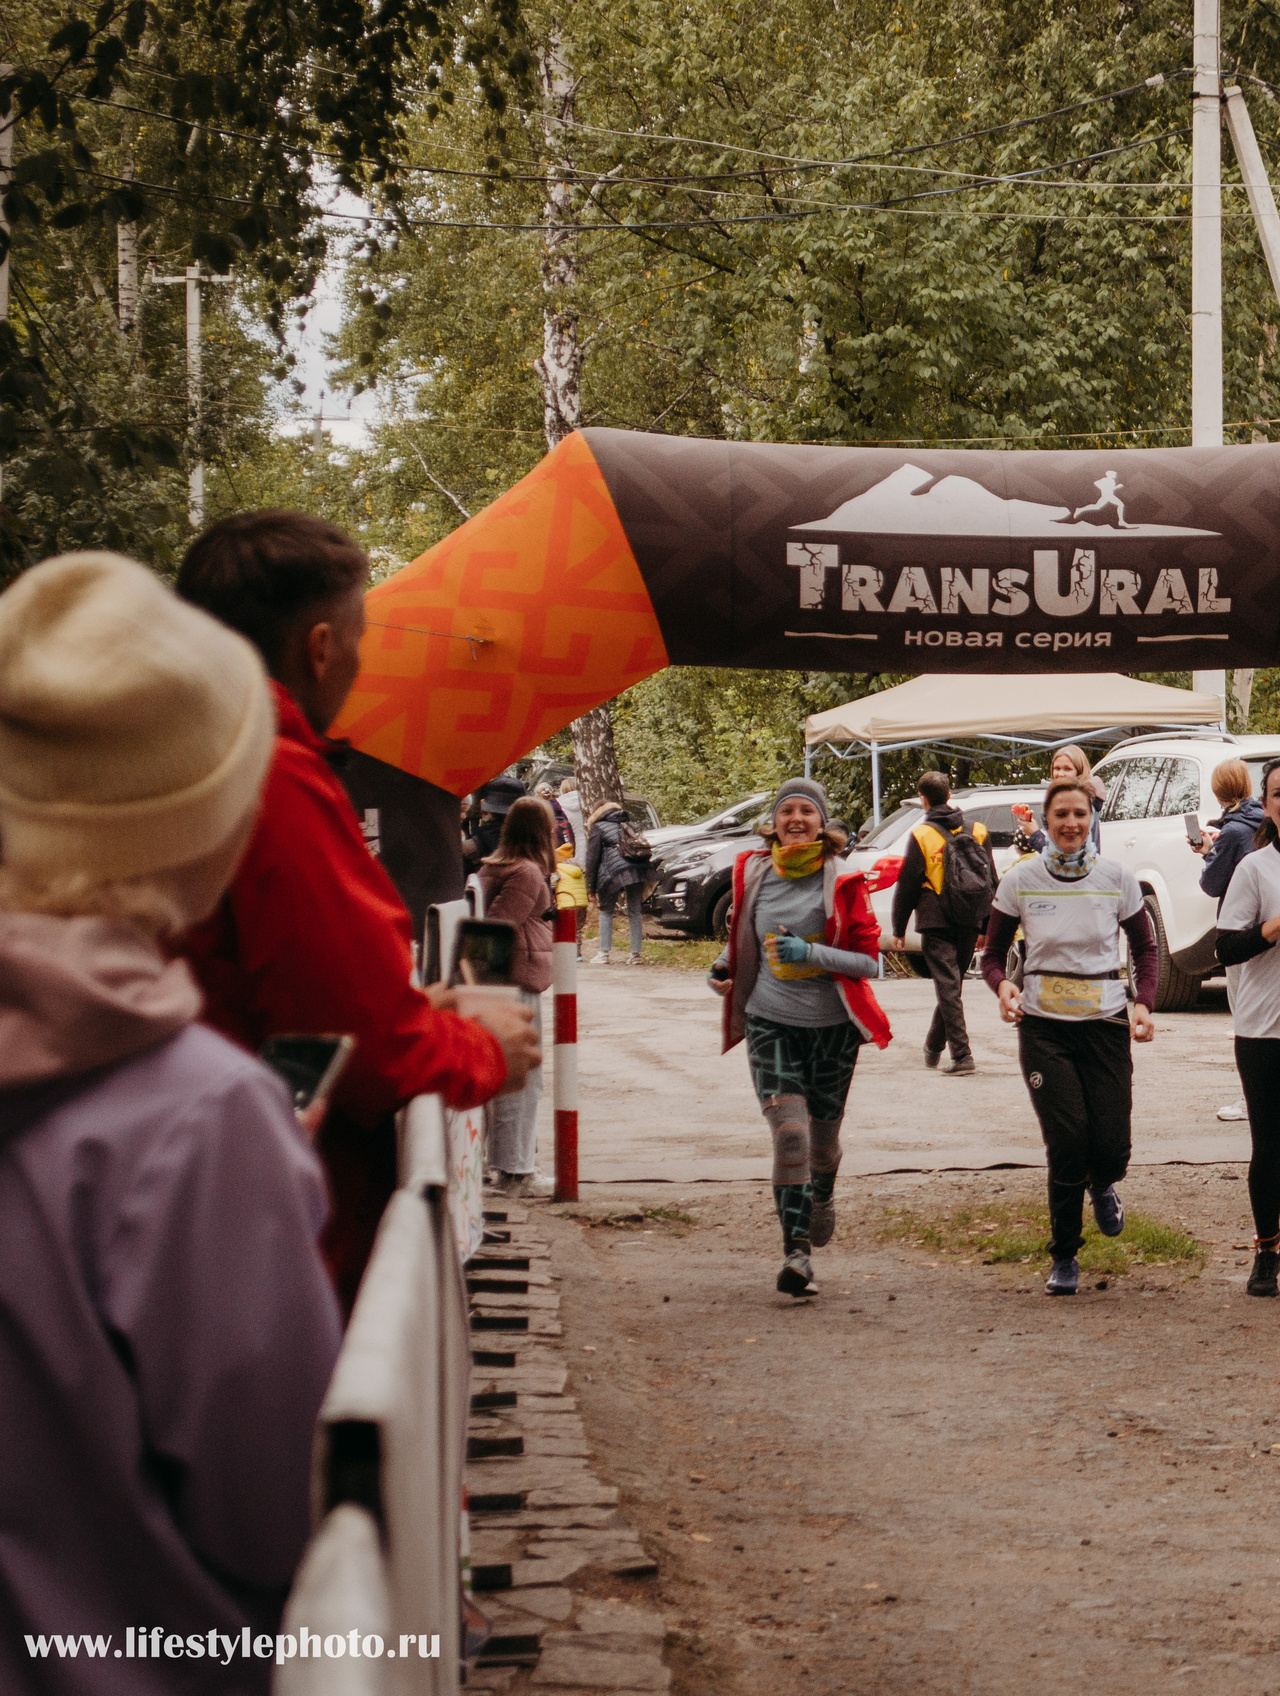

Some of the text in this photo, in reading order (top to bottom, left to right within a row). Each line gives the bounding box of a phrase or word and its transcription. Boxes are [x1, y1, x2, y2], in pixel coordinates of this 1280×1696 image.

[904, 629, 1112, 651] новая серия
[1052, 980, 1089, 996] 623
